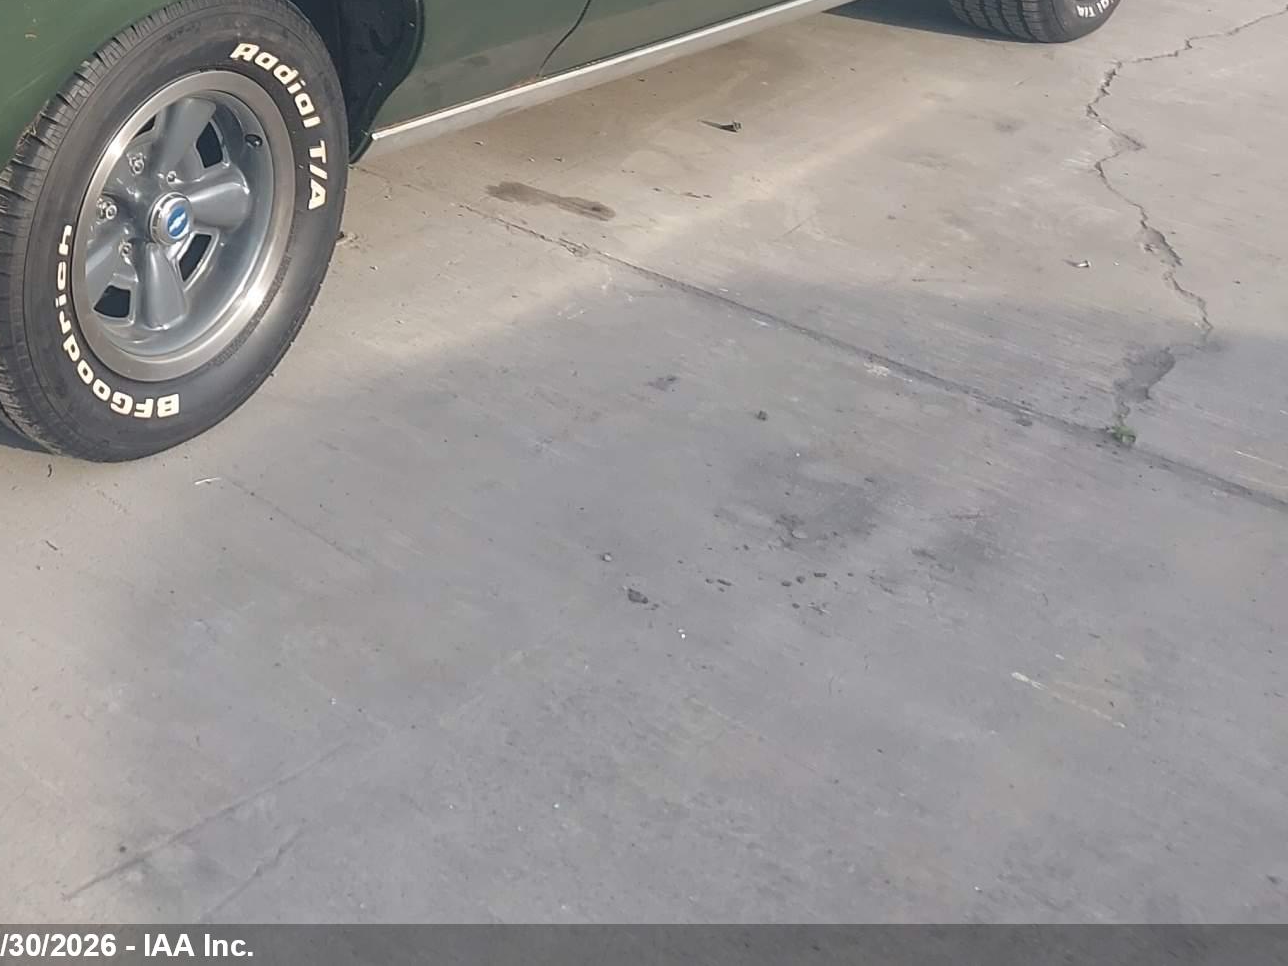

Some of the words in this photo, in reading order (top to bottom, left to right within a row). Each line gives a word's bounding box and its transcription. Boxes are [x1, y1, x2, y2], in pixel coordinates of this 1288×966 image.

[1076, 5, 1096, 18] T/A
[230, 43, 321, 128] Radial
[308, 140, 328, 210] T/A
[55, 225, 180, 418] BFGoodrich
